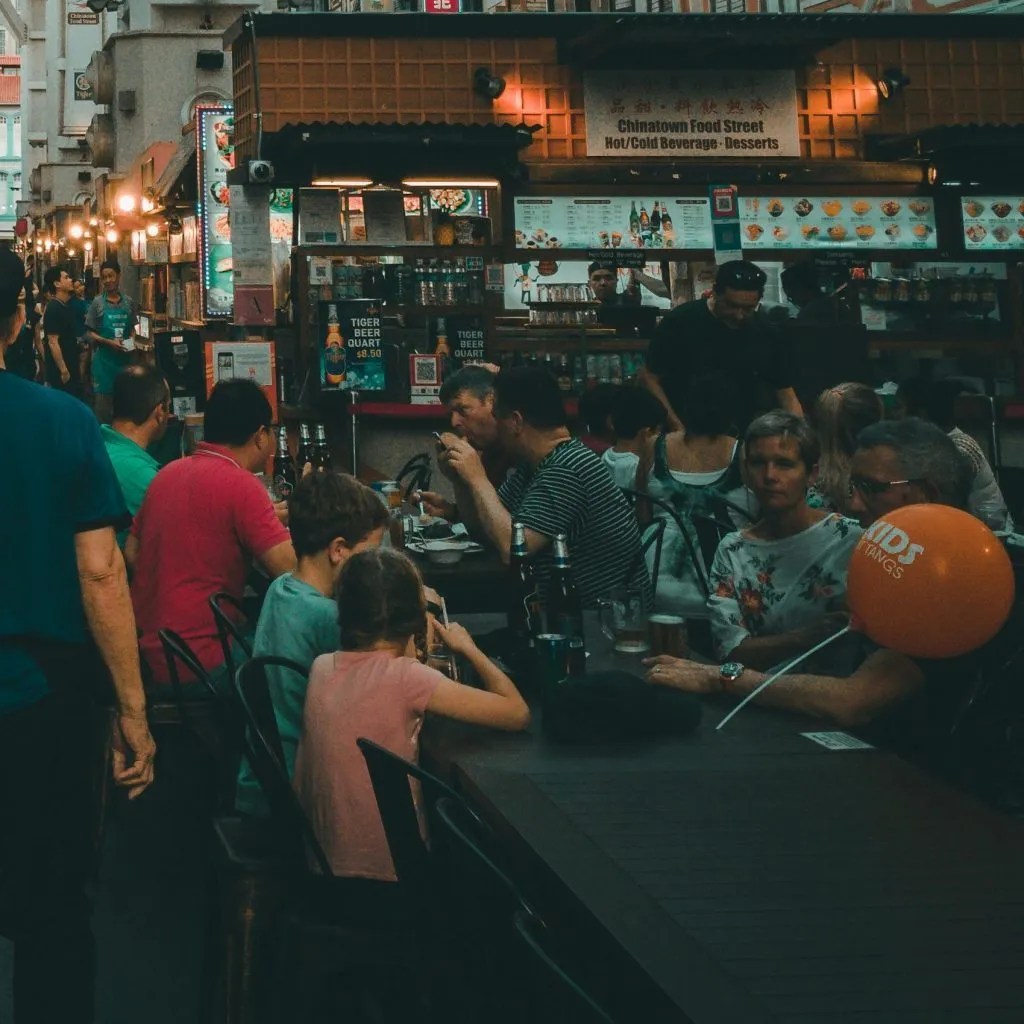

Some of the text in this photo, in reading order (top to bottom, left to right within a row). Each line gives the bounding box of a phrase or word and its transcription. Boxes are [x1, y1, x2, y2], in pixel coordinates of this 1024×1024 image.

[617, 119, 765, 133] Chinatown Food Street
[605, 137, 779, 151] Hot/Cold Beverage Desserts
[351, 318, 380, 327] TIGER
[354, 328, 381, 337] BEER
[457, 330, 484, 339] TIGER
[347, 339, 381, 348] QUART
[460, 340, 484, 349] BEER
[356, 349, 382, 358] $8.50
[454, 349, 484, 358] QUART
[864, 543, 905, 579] TANGS
